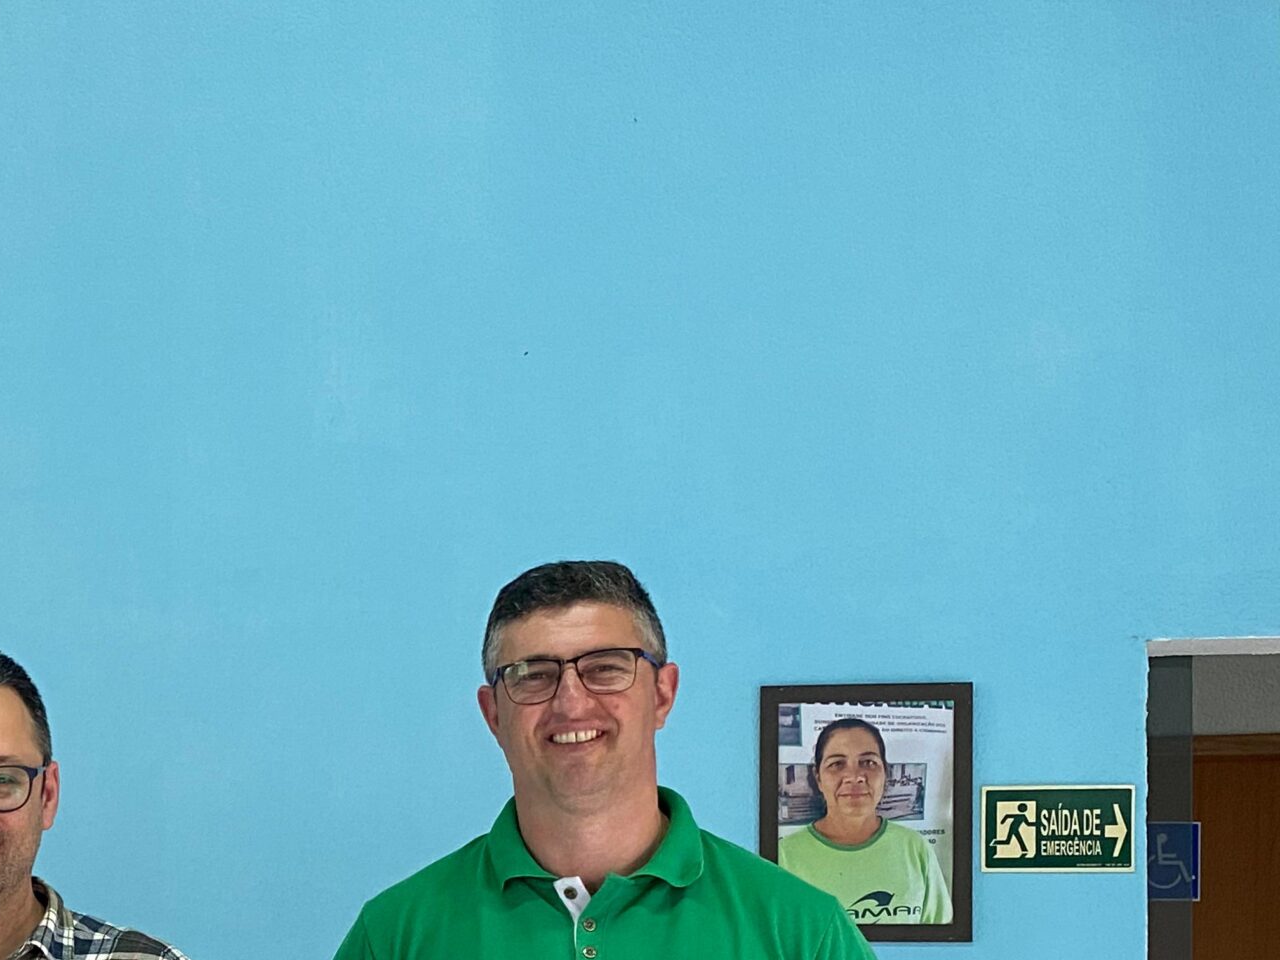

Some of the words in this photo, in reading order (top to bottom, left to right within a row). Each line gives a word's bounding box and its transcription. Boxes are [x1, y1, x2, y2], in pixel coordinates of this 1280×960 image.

[1040, 803, 1081, 836] SAÍDA
[1083, 808, 1101, 836] DE
[1040, 837, 1102, 856] EMERGÊNCIA
